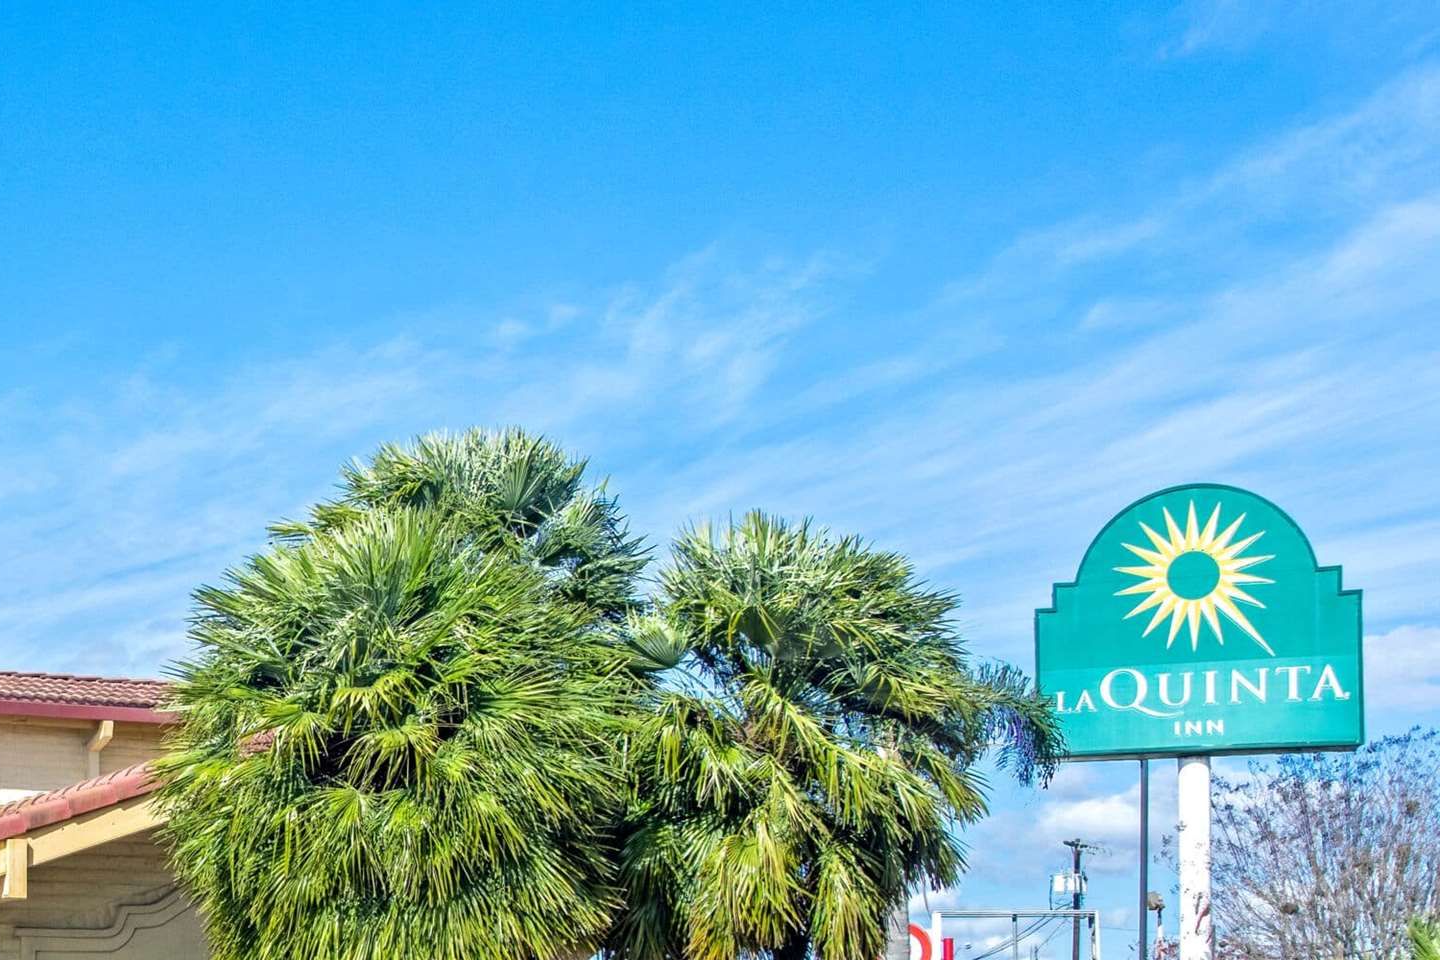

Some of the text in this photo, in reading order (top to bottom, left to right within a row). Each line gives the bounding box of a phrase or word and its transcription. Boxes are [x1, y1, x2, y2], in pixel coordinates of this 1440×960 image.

[1055, 664, 1351, 718] LA QUINTA
[1173, 719, 1224, 736] INN
